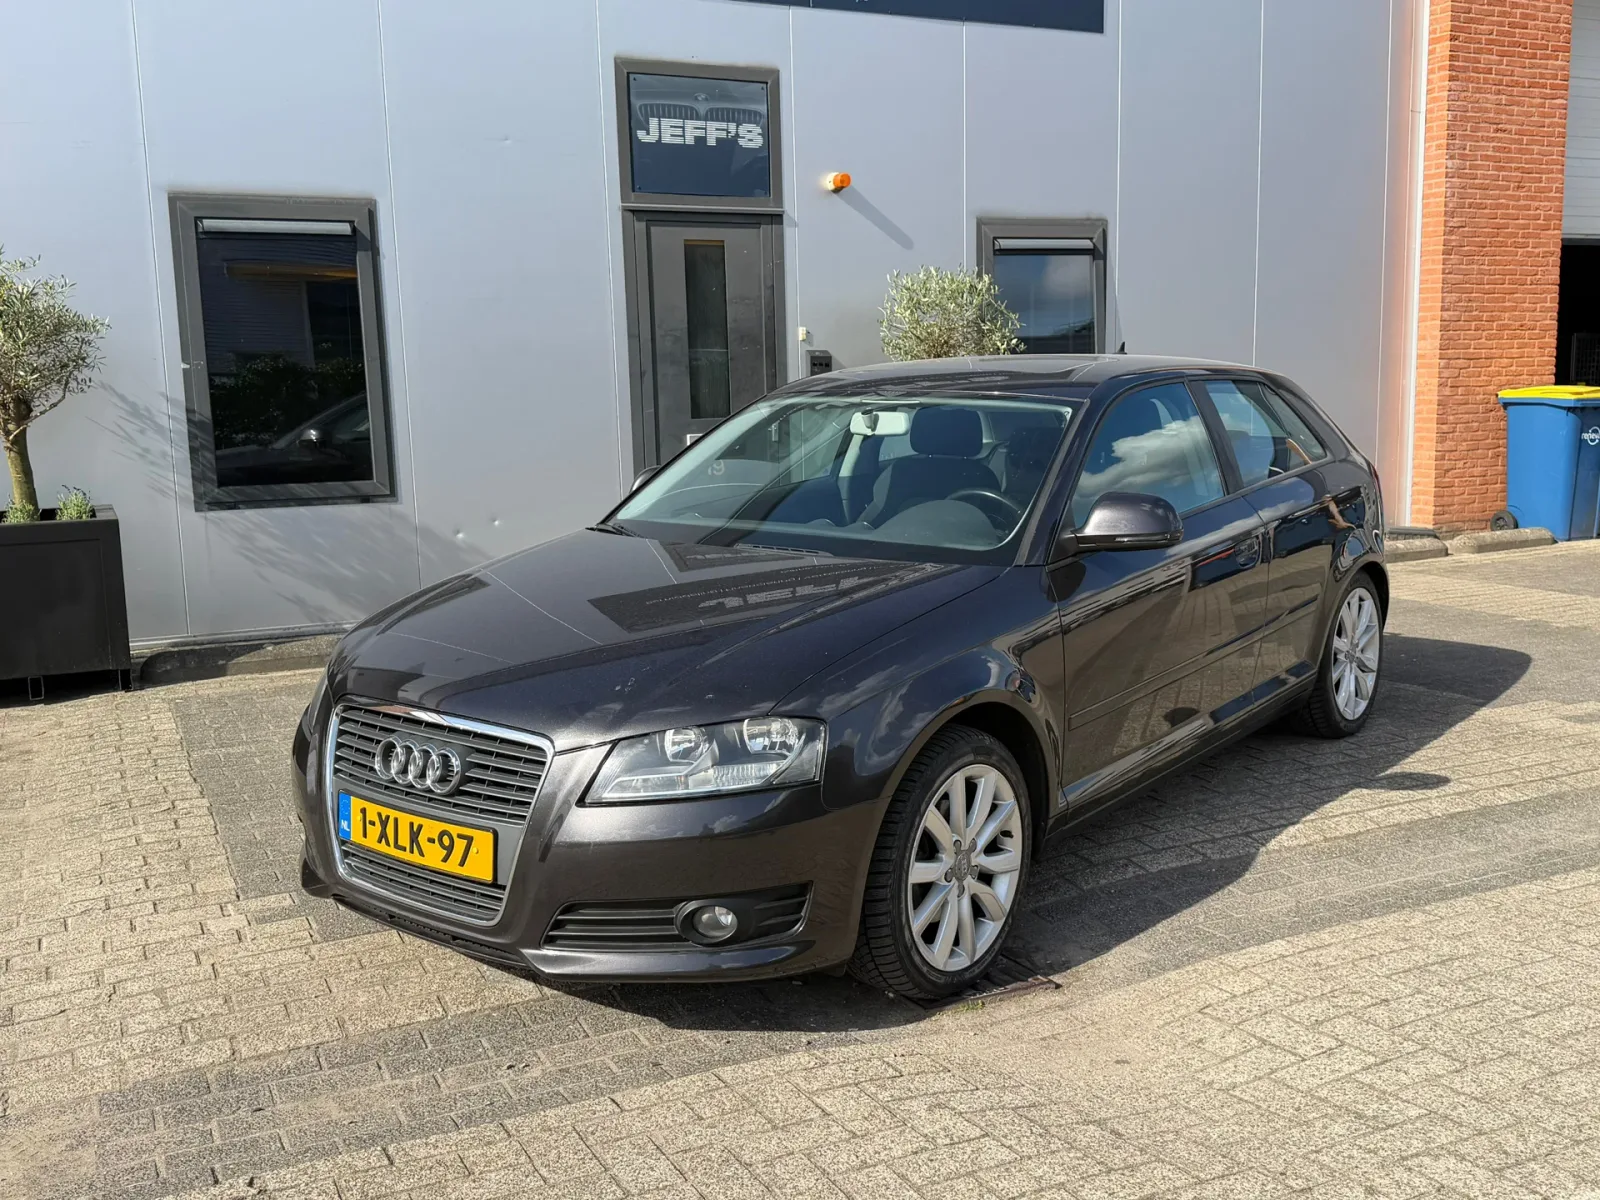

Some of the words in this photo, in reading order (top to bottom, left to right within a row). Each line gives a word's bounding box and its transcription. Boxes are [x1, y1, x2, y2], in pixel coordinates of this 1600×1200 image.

[636, 117, 764, 149] JEFF'S
[340, 819, 351, 832] NL
[359, 806, 475, 868] 1-XLK-97
